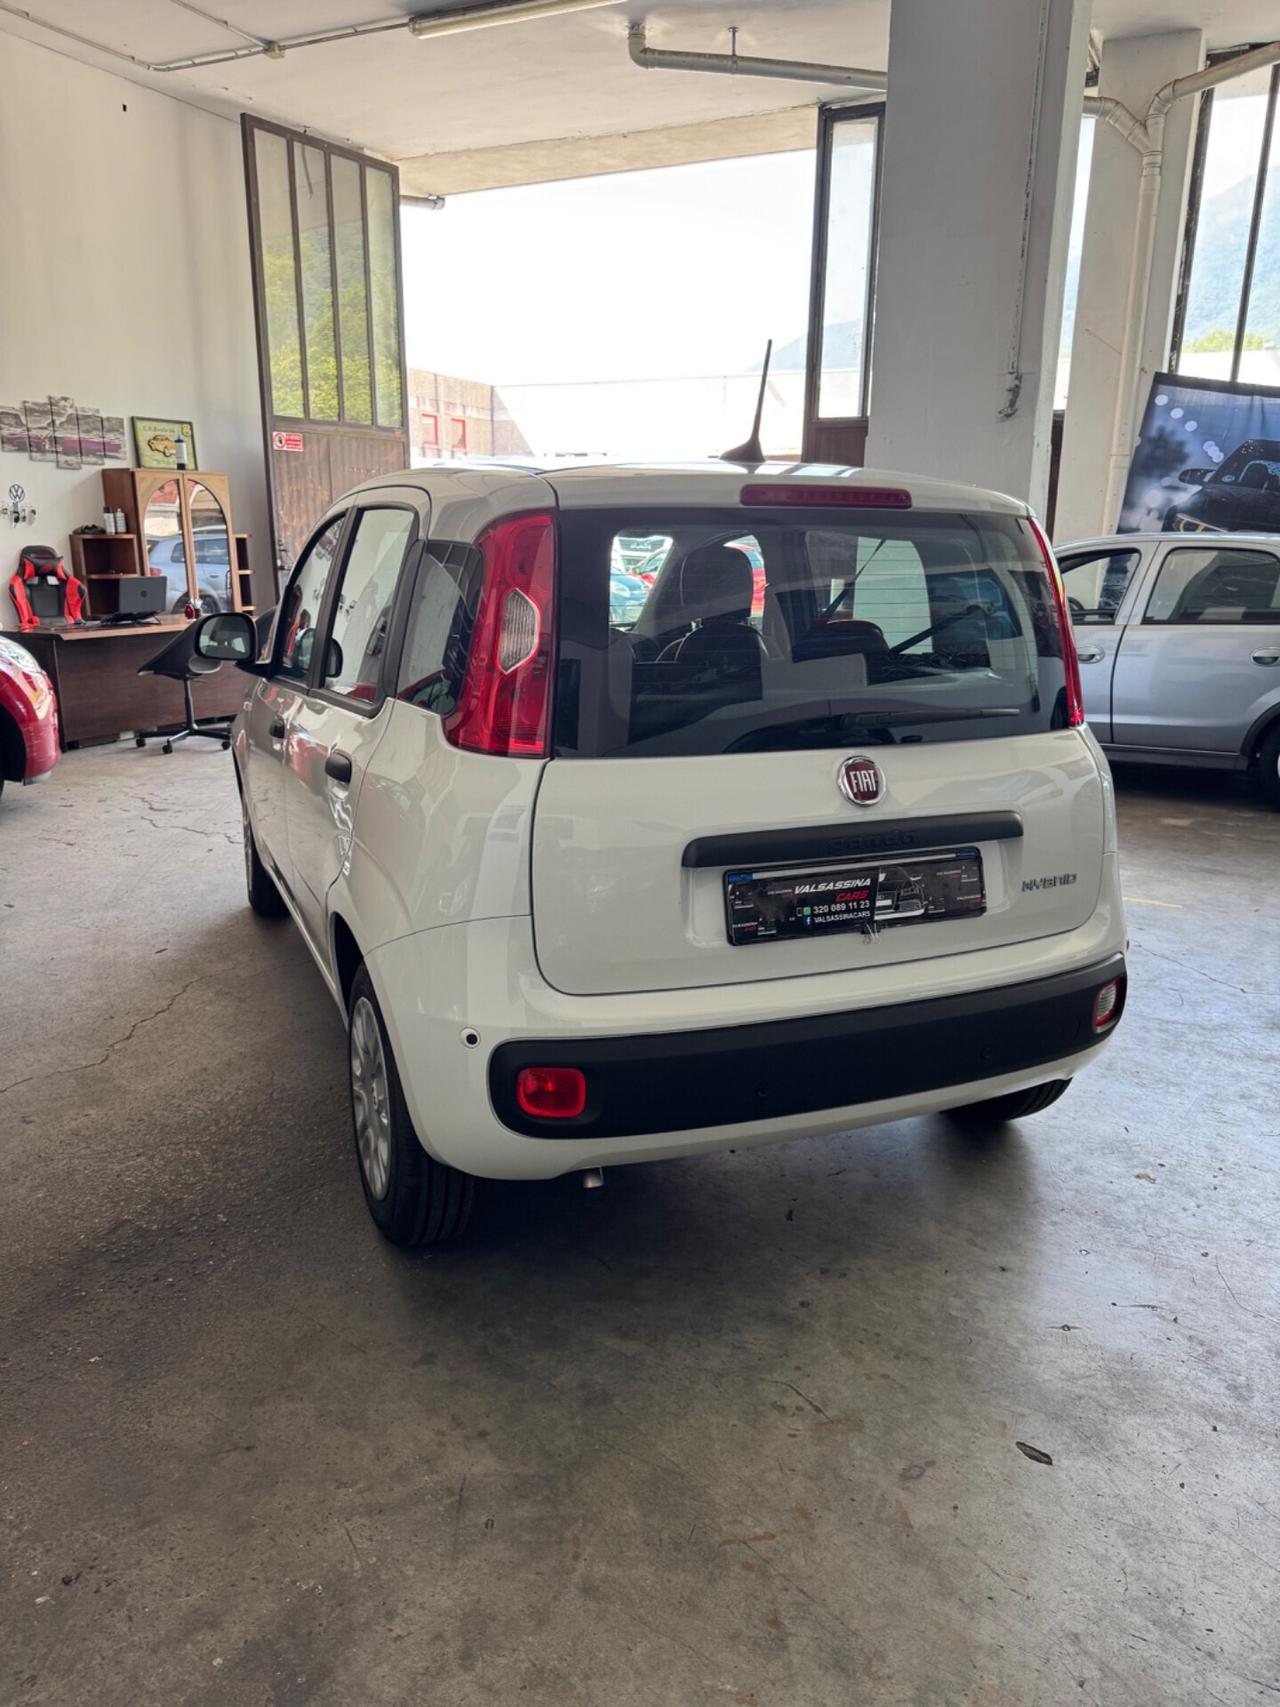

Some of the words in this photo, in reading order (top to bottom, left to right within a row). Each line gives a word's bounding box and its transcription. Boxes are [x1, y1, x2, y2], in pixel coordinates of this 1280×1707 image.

[849, 769, 875, 793] FIAT
[794, 878, 871, 894] VALSASSINA
[834, 890, 870, 902] CARS
[813, 905, 829, 914] 320
[848, 901, 858, 910] 11
[859, 899, 870, 908] 23
